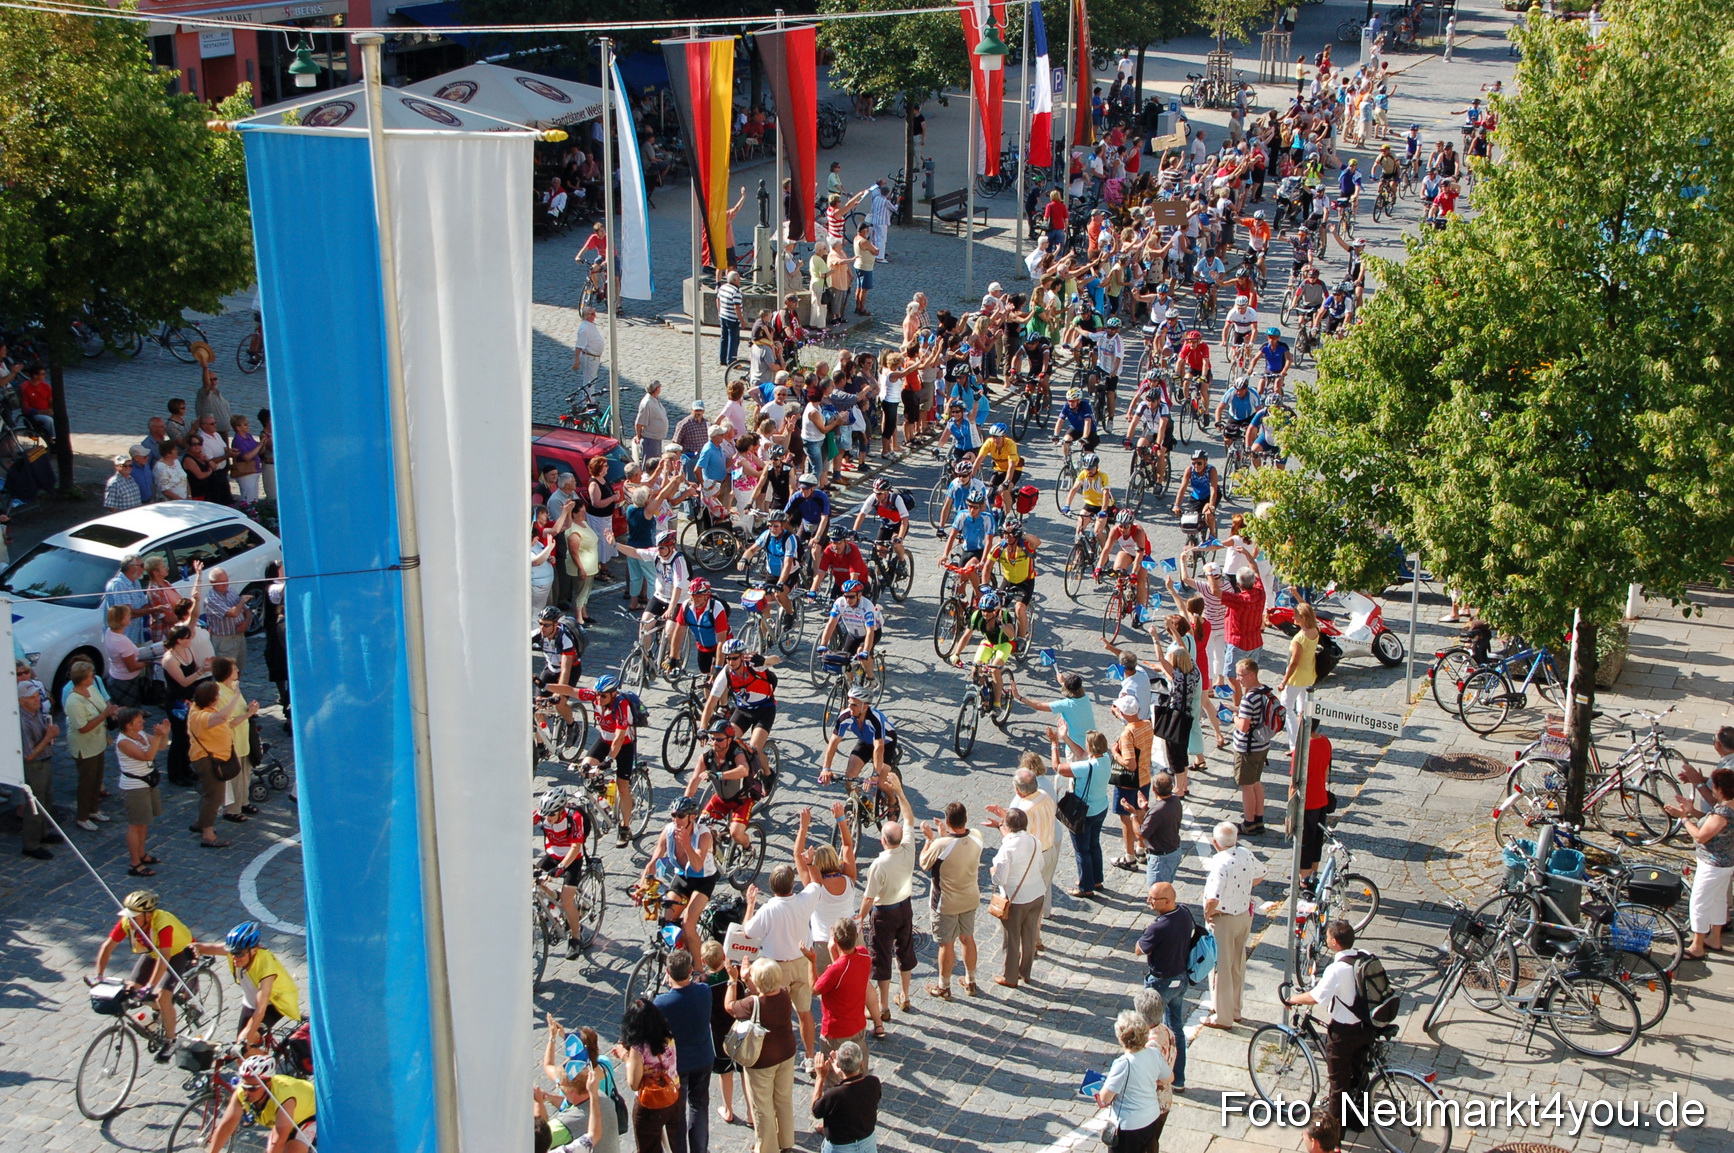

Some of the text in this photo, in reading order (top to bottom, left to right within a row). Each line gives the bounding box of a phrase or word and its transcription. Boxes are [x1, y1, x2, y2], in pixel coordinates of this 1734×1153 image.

[1055, 71, 1062, 91] P
[1314, 703, 1399, 732] Brunnwirtsgasse
[731, 943, 759, 954] Gong
